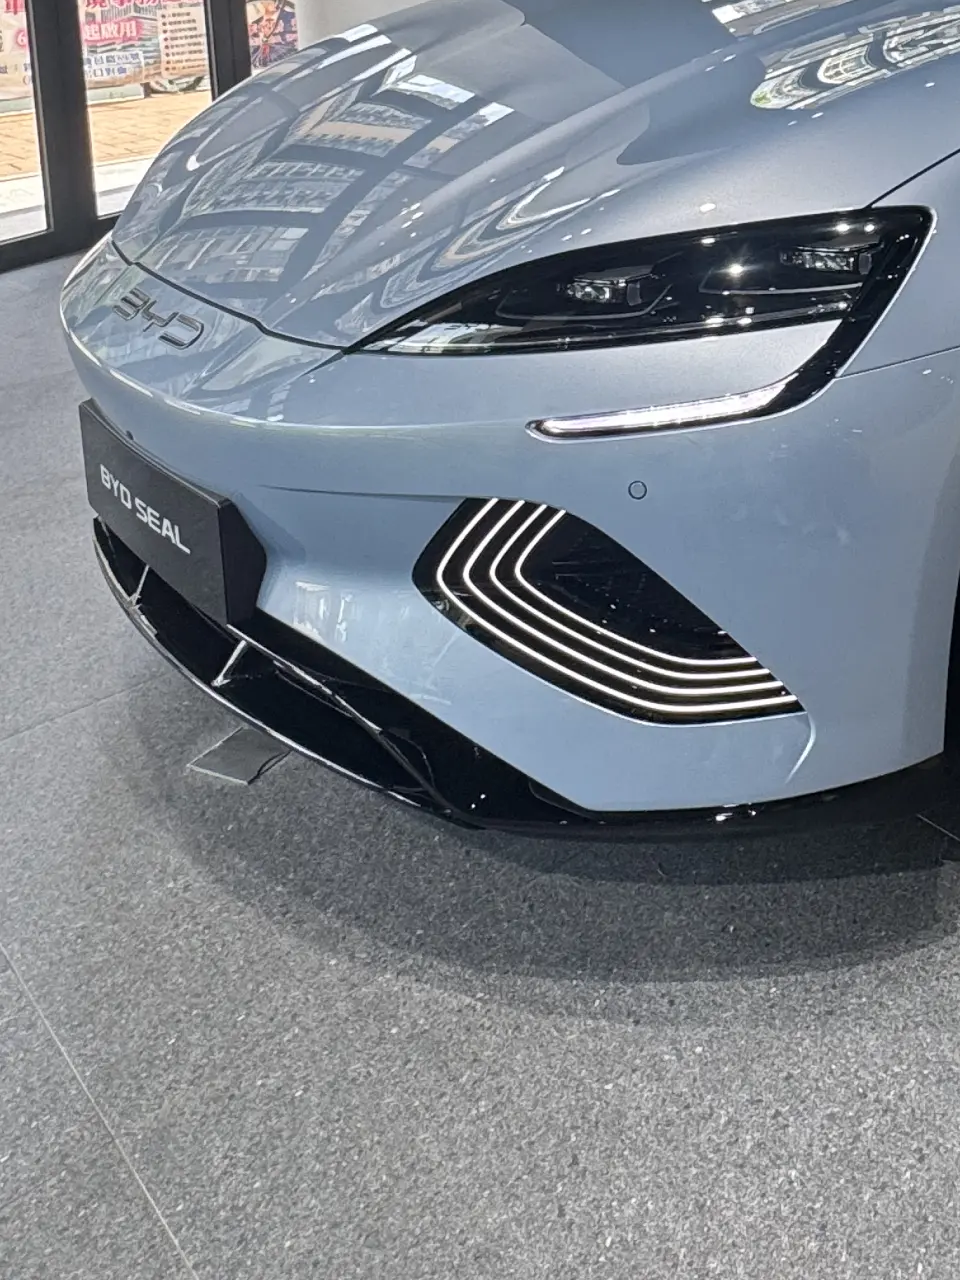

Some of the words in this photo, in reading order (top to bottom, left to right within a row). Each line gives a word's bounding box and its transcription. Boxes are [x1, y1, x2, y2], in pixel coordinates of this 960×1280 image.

[113, 288, 205, 350] BYD
[100, 463, 132, 510] BYD
[135, 496, 191, 555] SEAL
